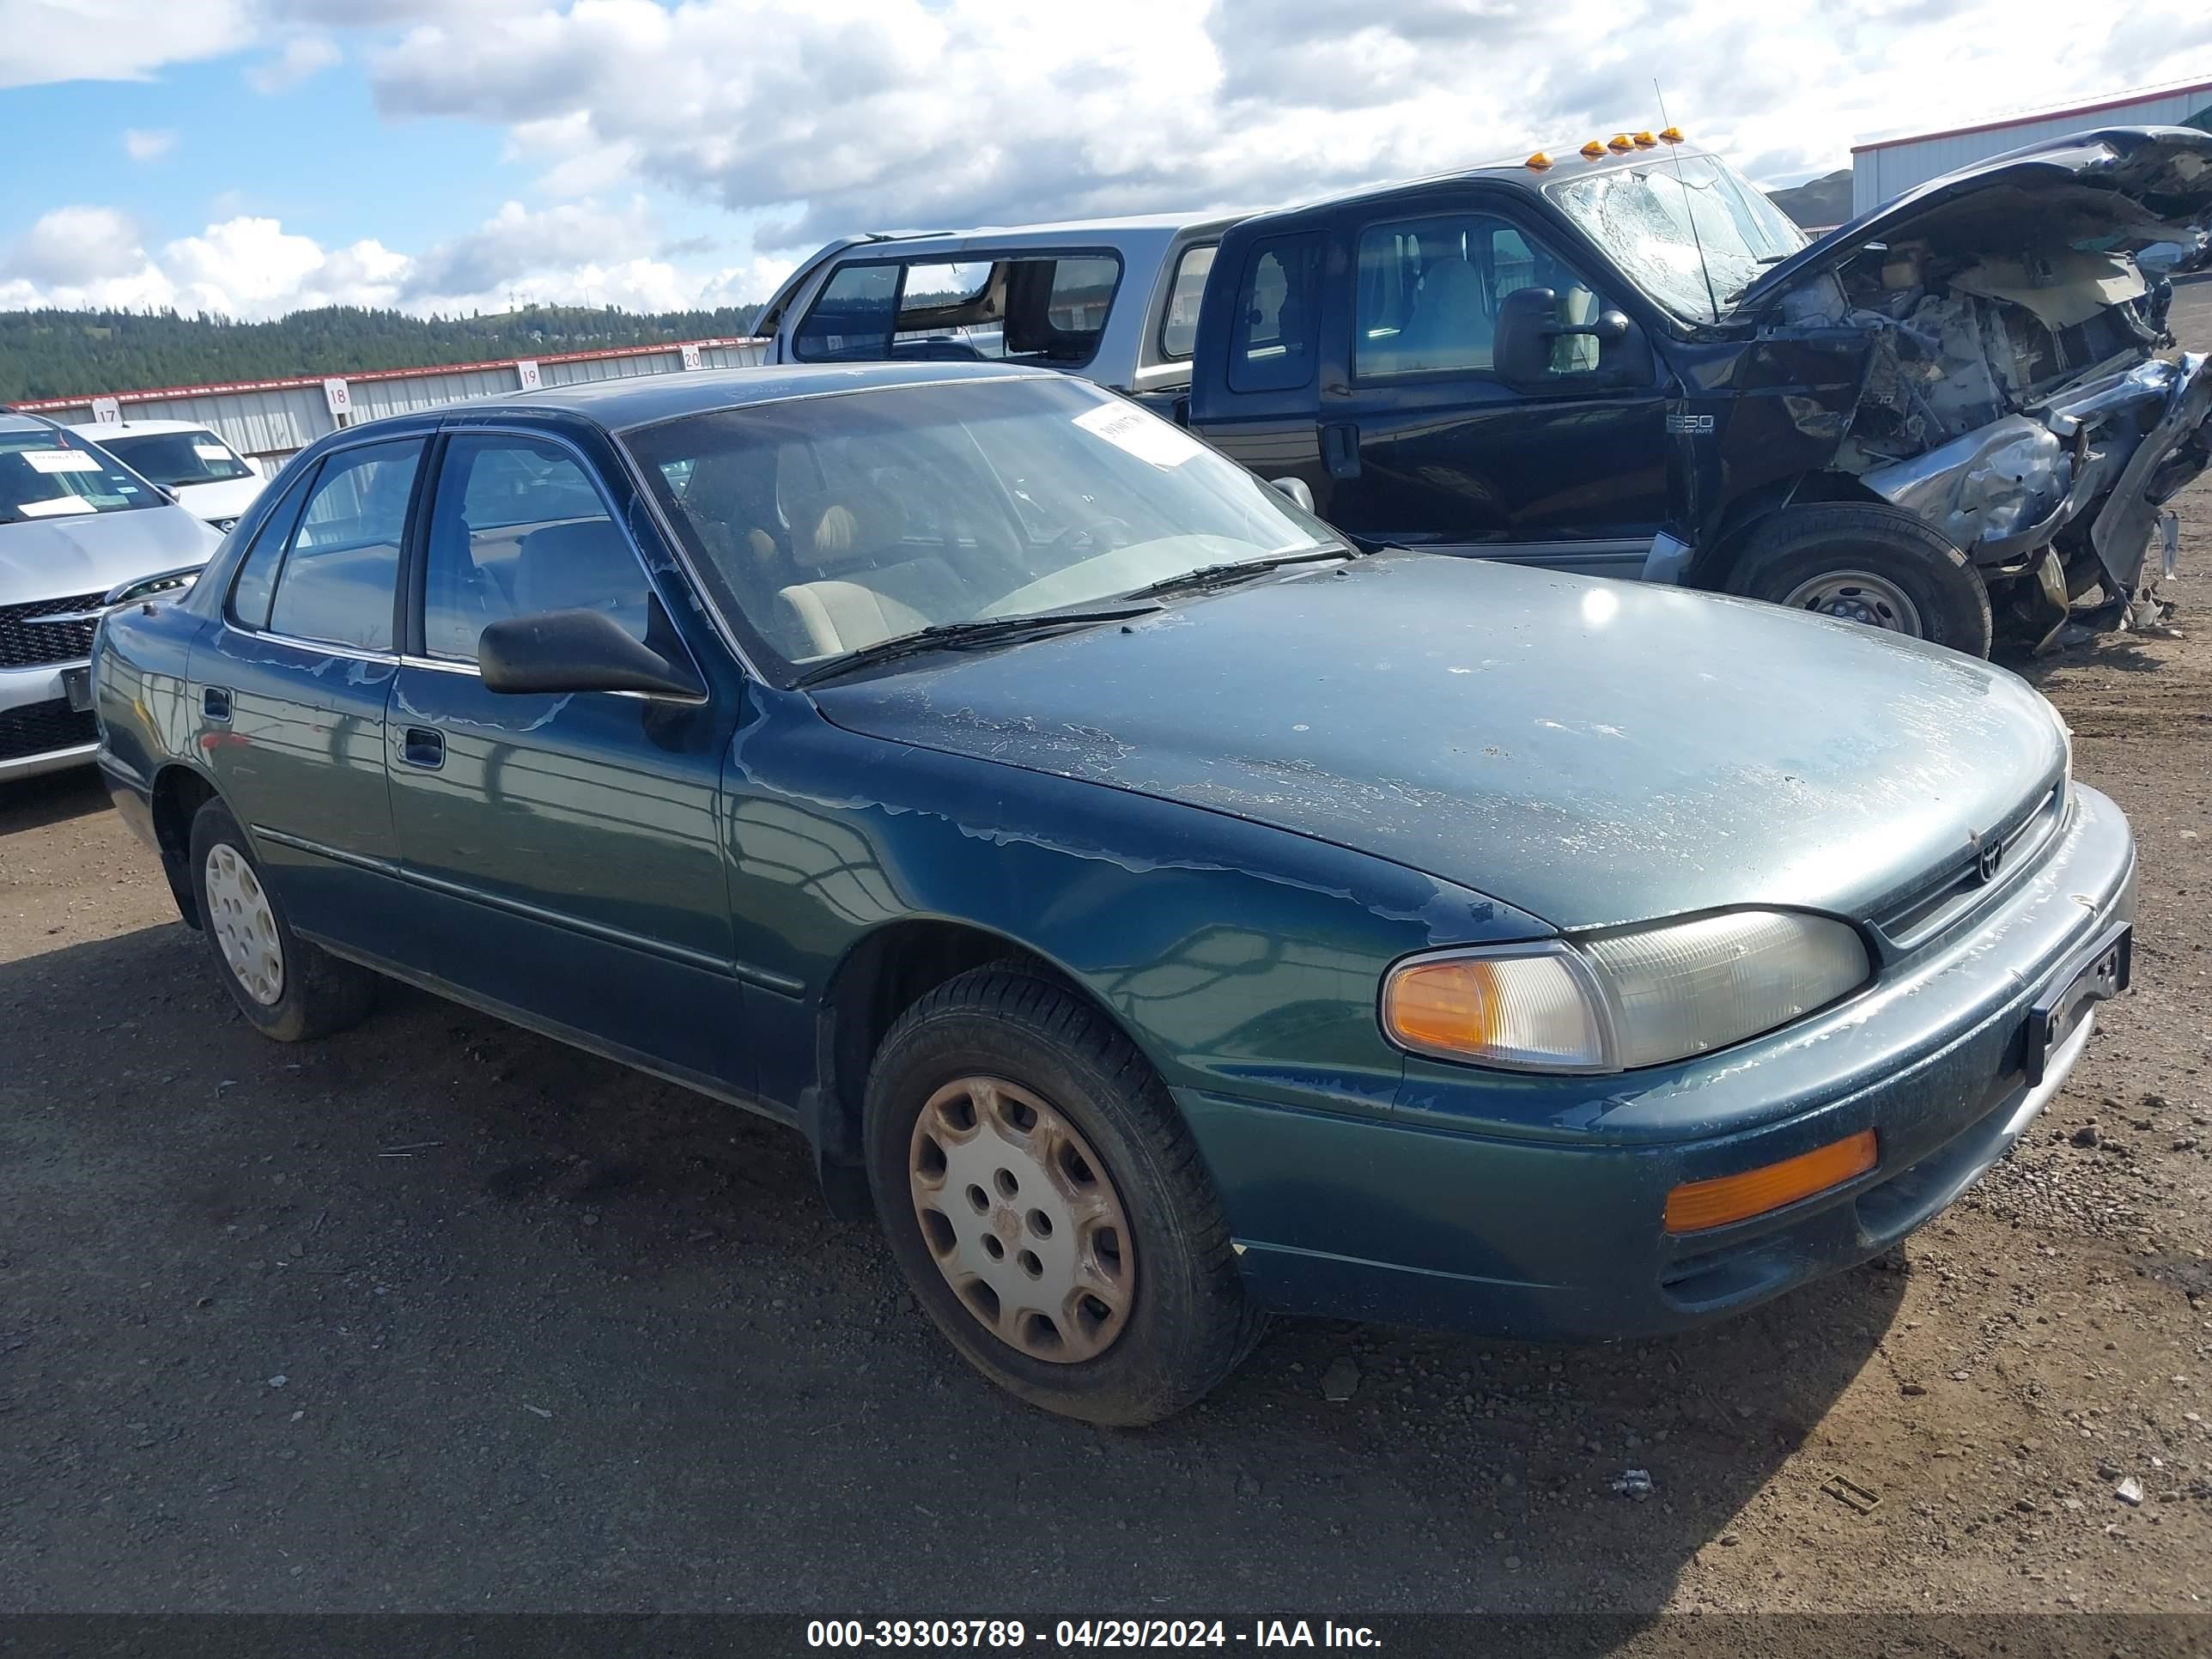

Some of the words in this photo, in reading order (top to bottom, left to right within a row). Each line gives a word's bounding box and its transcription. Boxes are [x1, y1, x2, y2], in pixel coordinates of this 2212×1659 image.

[684, 352, 700, 368] 20
[523, 370, 536, 384] 19
[331, 389, 346, 404] 18
[99, 410, 115, 422] 17
